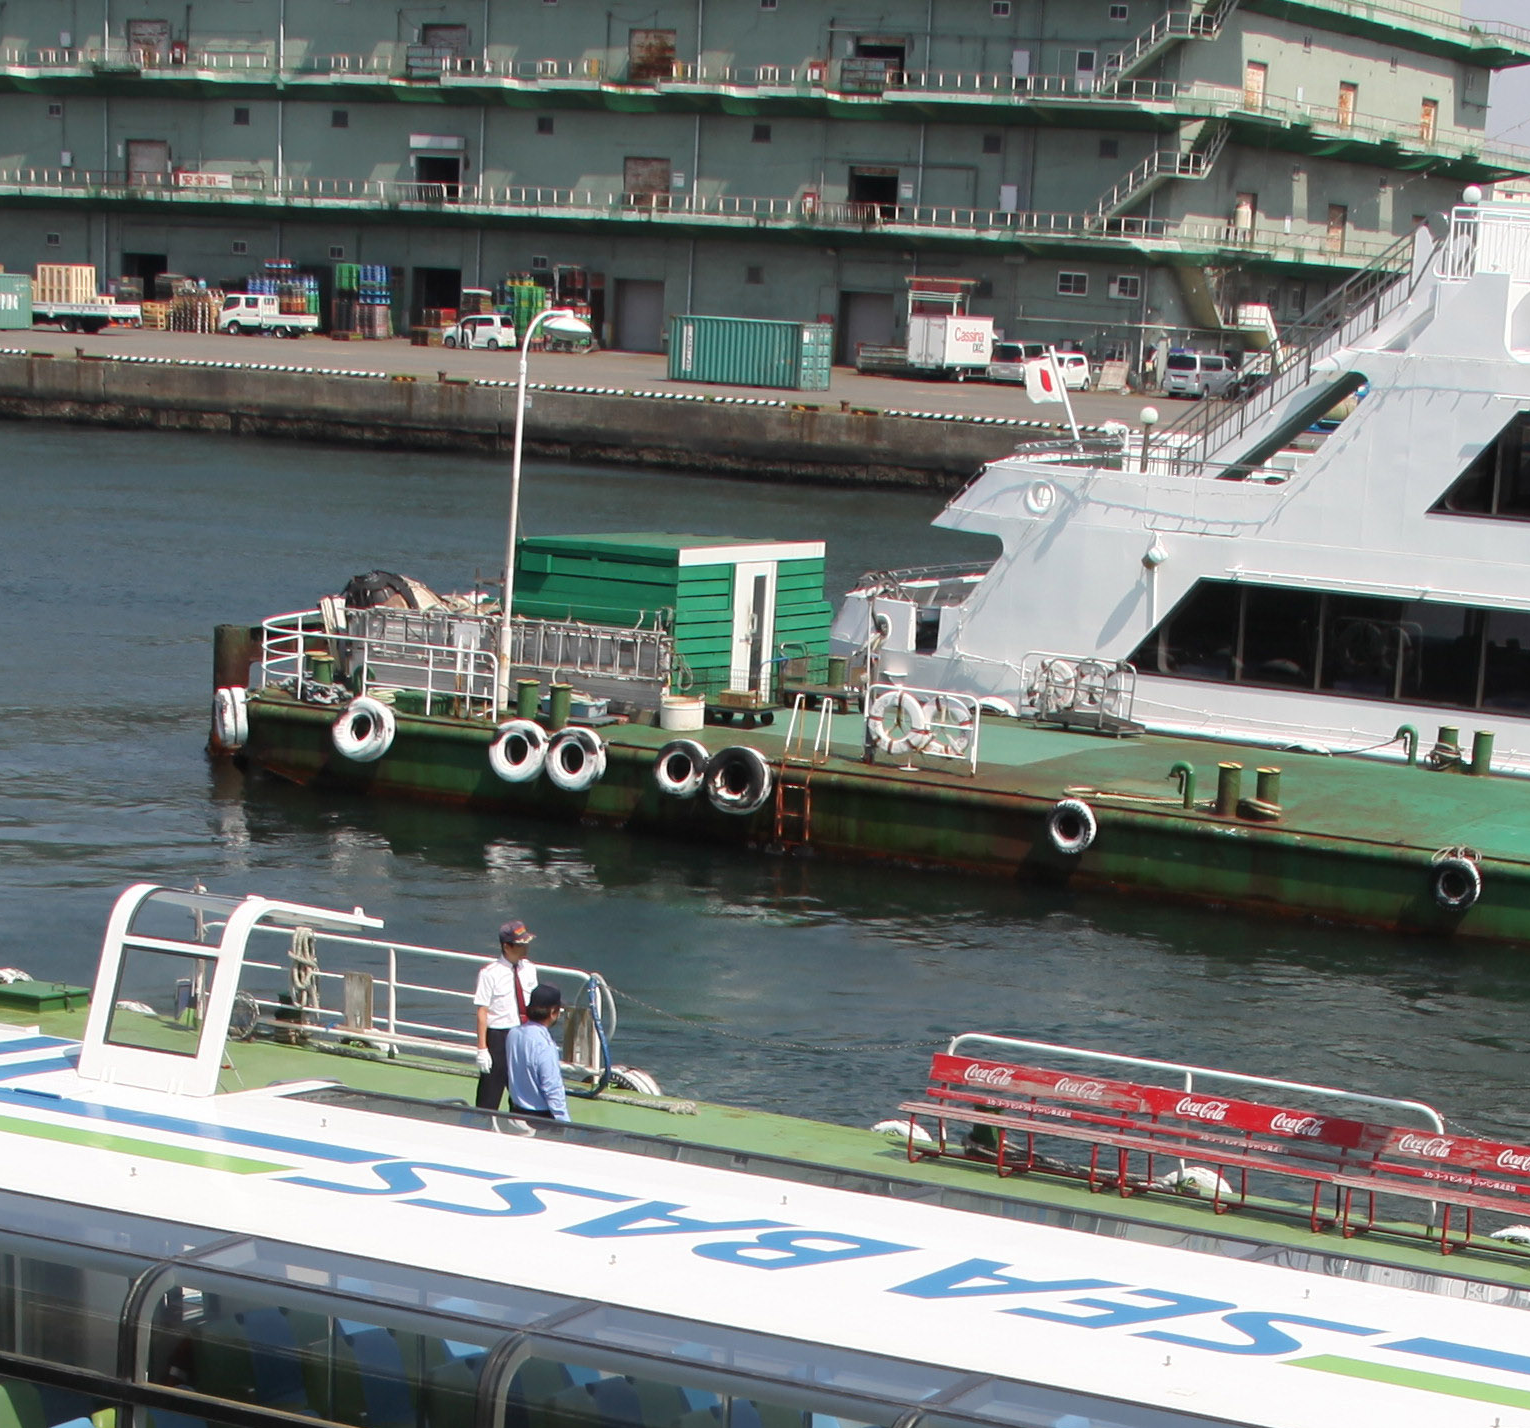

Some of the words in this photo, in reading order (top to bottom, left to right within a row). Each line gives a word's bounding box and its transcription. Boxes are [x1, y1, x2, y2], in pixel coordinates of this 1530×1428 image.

[954, 327, 985, 342] Cassina
[269, 1159, 923, 1272] BASS
[884, 1256, 1391, 1358] SEA
